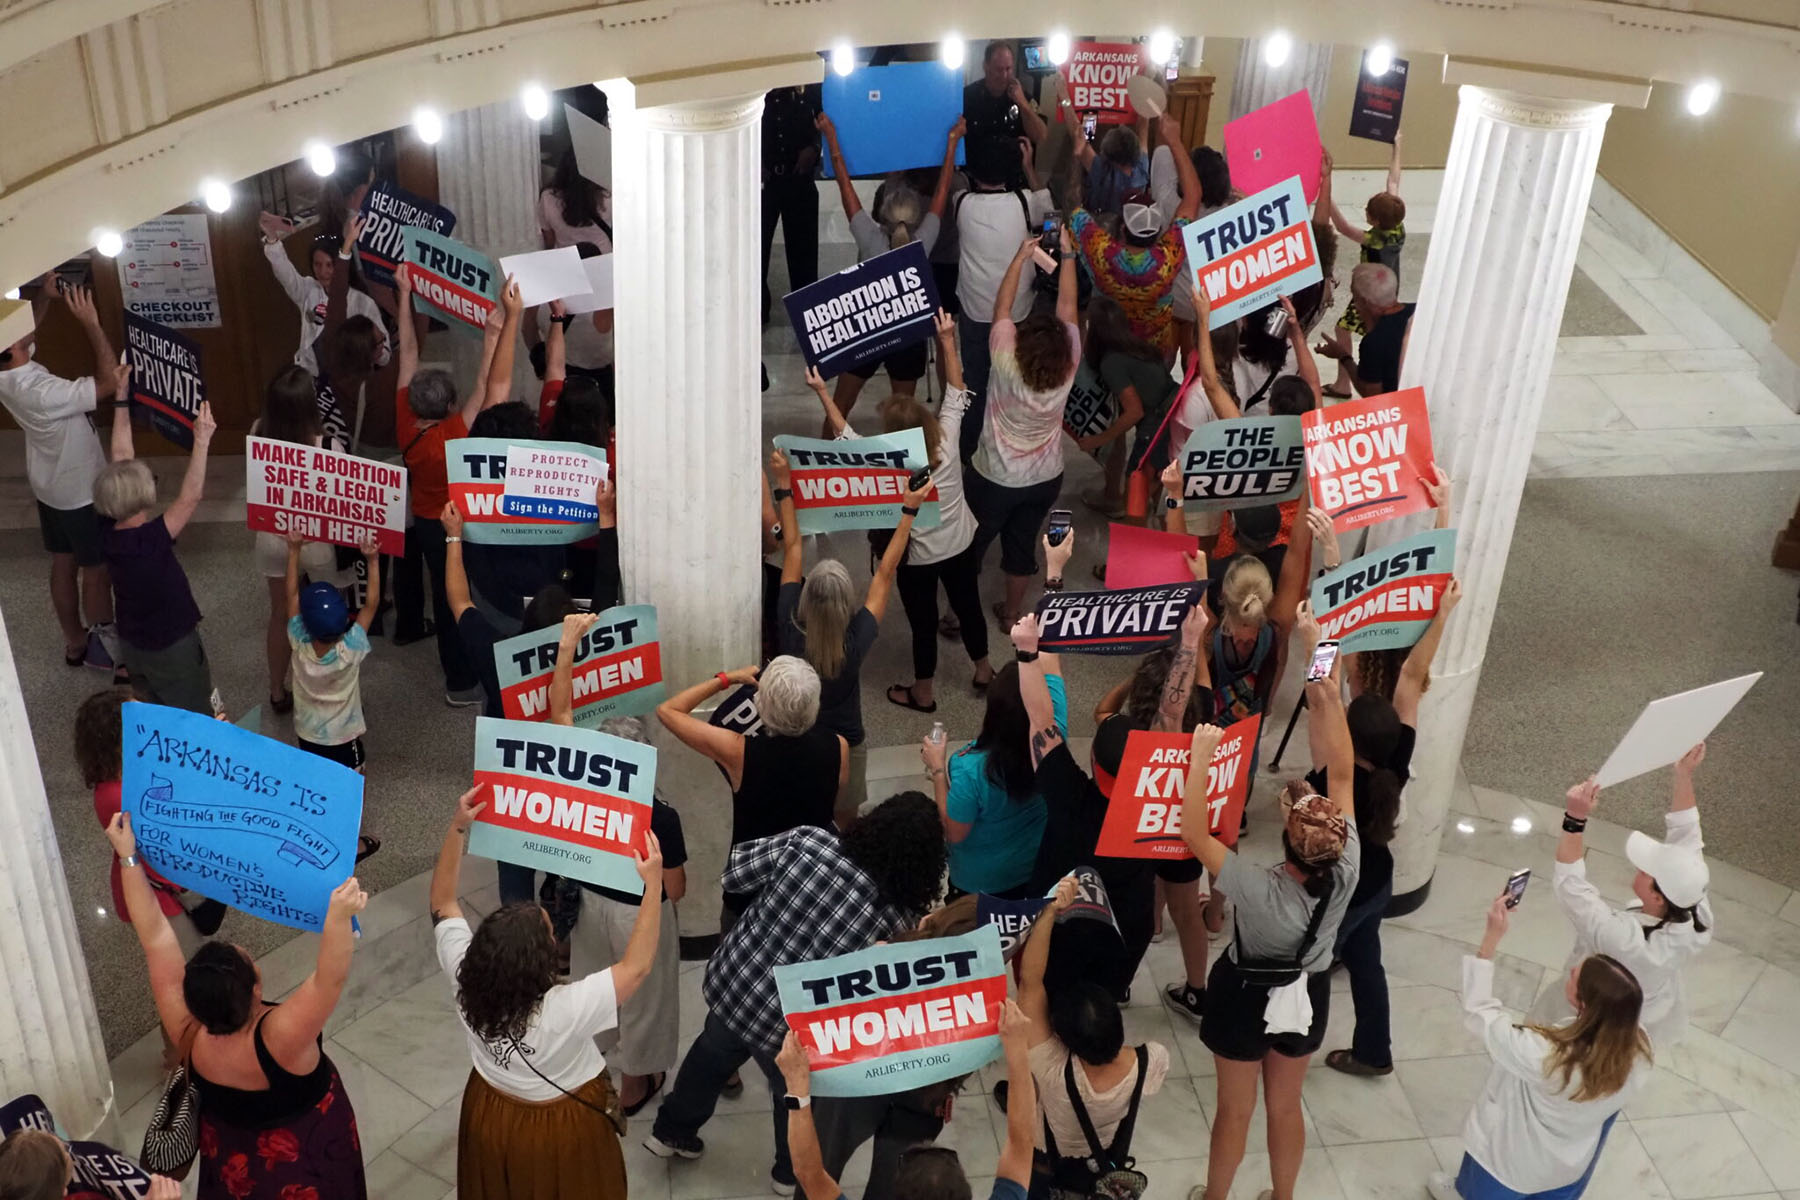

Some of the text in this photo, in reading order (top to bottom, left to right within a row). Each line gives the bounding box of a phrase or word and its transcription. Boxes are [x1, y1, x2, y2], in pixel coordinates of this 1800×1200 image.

[1069, 63, 1140, 85] KNOW
[1074, 51, 1138, 64] ARKANSANS
[1074, 87, 1129, 108] BEST
[371, 190, 444, 233] HEALTHCARE IS
[1197, 193, 1291, 262] TRUST
[358, 211, 405, 262] PRIV
[415, 239, 490, 293] TRUST
[1203, 231, 1307, 301] WOMEN
[130, 301, 212, 313] CHECKOUT
[143, 312, 215, 323] HECKLIST
[413, 274, 489, 324] WOMEN
[803, 266, 921, 332] ABORTION IS
[808, 288, 930, 355] HEALTHCARE
[128, 324, 190, 369] HEALTHCARE
[131, 346, 202, 416] PRIVATE
[1224, 426, 1275, 447] THE
[1306, 407, 1401, 443] ARKANSANS
[252, 441, 400, 489] MAKE ABORTION
[531, 453, 589, 468] PROTECT
[789, 448, 910, 469] TRUST
[1185, 445, 1304, 471] PEOPLE
[1307, 424, 1408, 478] KNOW
[264, 465, 388, 506] SAFE & LEGAL
[510, 467, 599, 487] REPRODUCTIV
[534, 484, 580, 498] RIGHTS
[1184, 471, 1293, 498] RULE
[1320, 461, 1401, 510] BEST
[266, 486, 386, 525] IN ARKANSAS
[510, 501, 533, 514] Sign
[537, 503, 553, 514] the
[558, 505, 599, 519] Petition
[274, 511, 378, 545] SIGN HERE
[1323, 546, 1436, 609] TRUST
[1048, 587, 1192, 609] HEALTHCARE IS
[1321, 585, 1434, 641] WOMEN
[1037, 599, 1186, 638] PRIVATE
[512, 618, 638, 677] TRUST
[517, 656, 644, 718] WMEN
[573, 702, 616, 723] BERTY.ORG
[496, 738, 638, 793] TRUST
[1149, 736, 1242, 764] ARKSANS
[290, 783, 328, 817] IS
[493, 784, 634, 845] WOMEN
[1136, 796, 1229, 834] BET
[145, 800, 331, 857] FIGHTING THE GOOD FIGHT
[140, 824, 265, 879] FOR WOMEN'S
[522, 841, 592, 865] ARLIBERTY.ORG
[232, 889, 320, 925] RIGHTS
[801, 950, 978, 1006] TRUST
[808, 991, 988, 1056] WOMEN
[864, 1053, 951, 1080] ARLIBERTY.ORG
